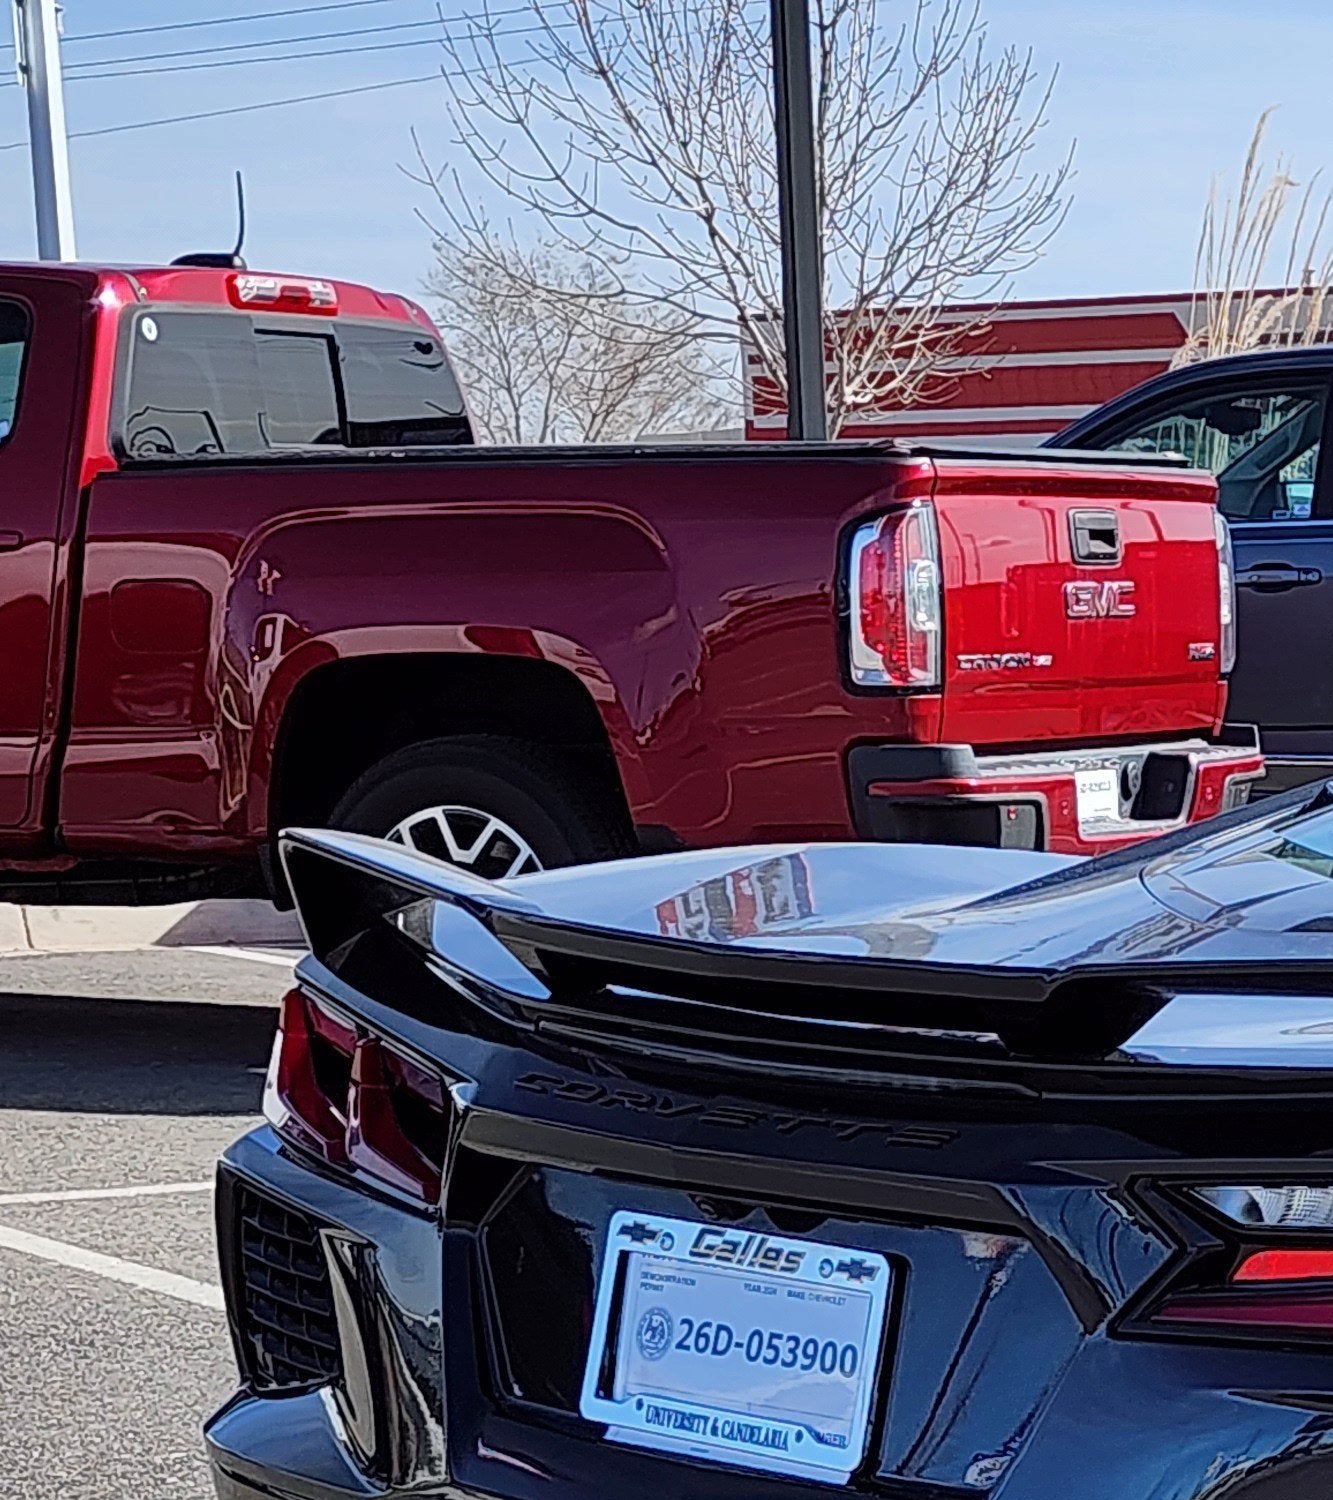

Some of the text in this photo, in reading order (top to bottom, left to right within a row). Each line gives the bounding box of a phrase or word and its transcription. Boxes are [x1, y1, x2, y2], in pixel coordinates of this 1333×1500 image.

[1061, 580, 1136, 617] GMC
[513, 1073, 962, 1149] CORVETTE
[688, 1227, 807, 1274] Galles
[675, 1317, 859, 1379] 26D-053900
[645, 1403, 790, 1452] UNIVERSITY & CANDELARIA
